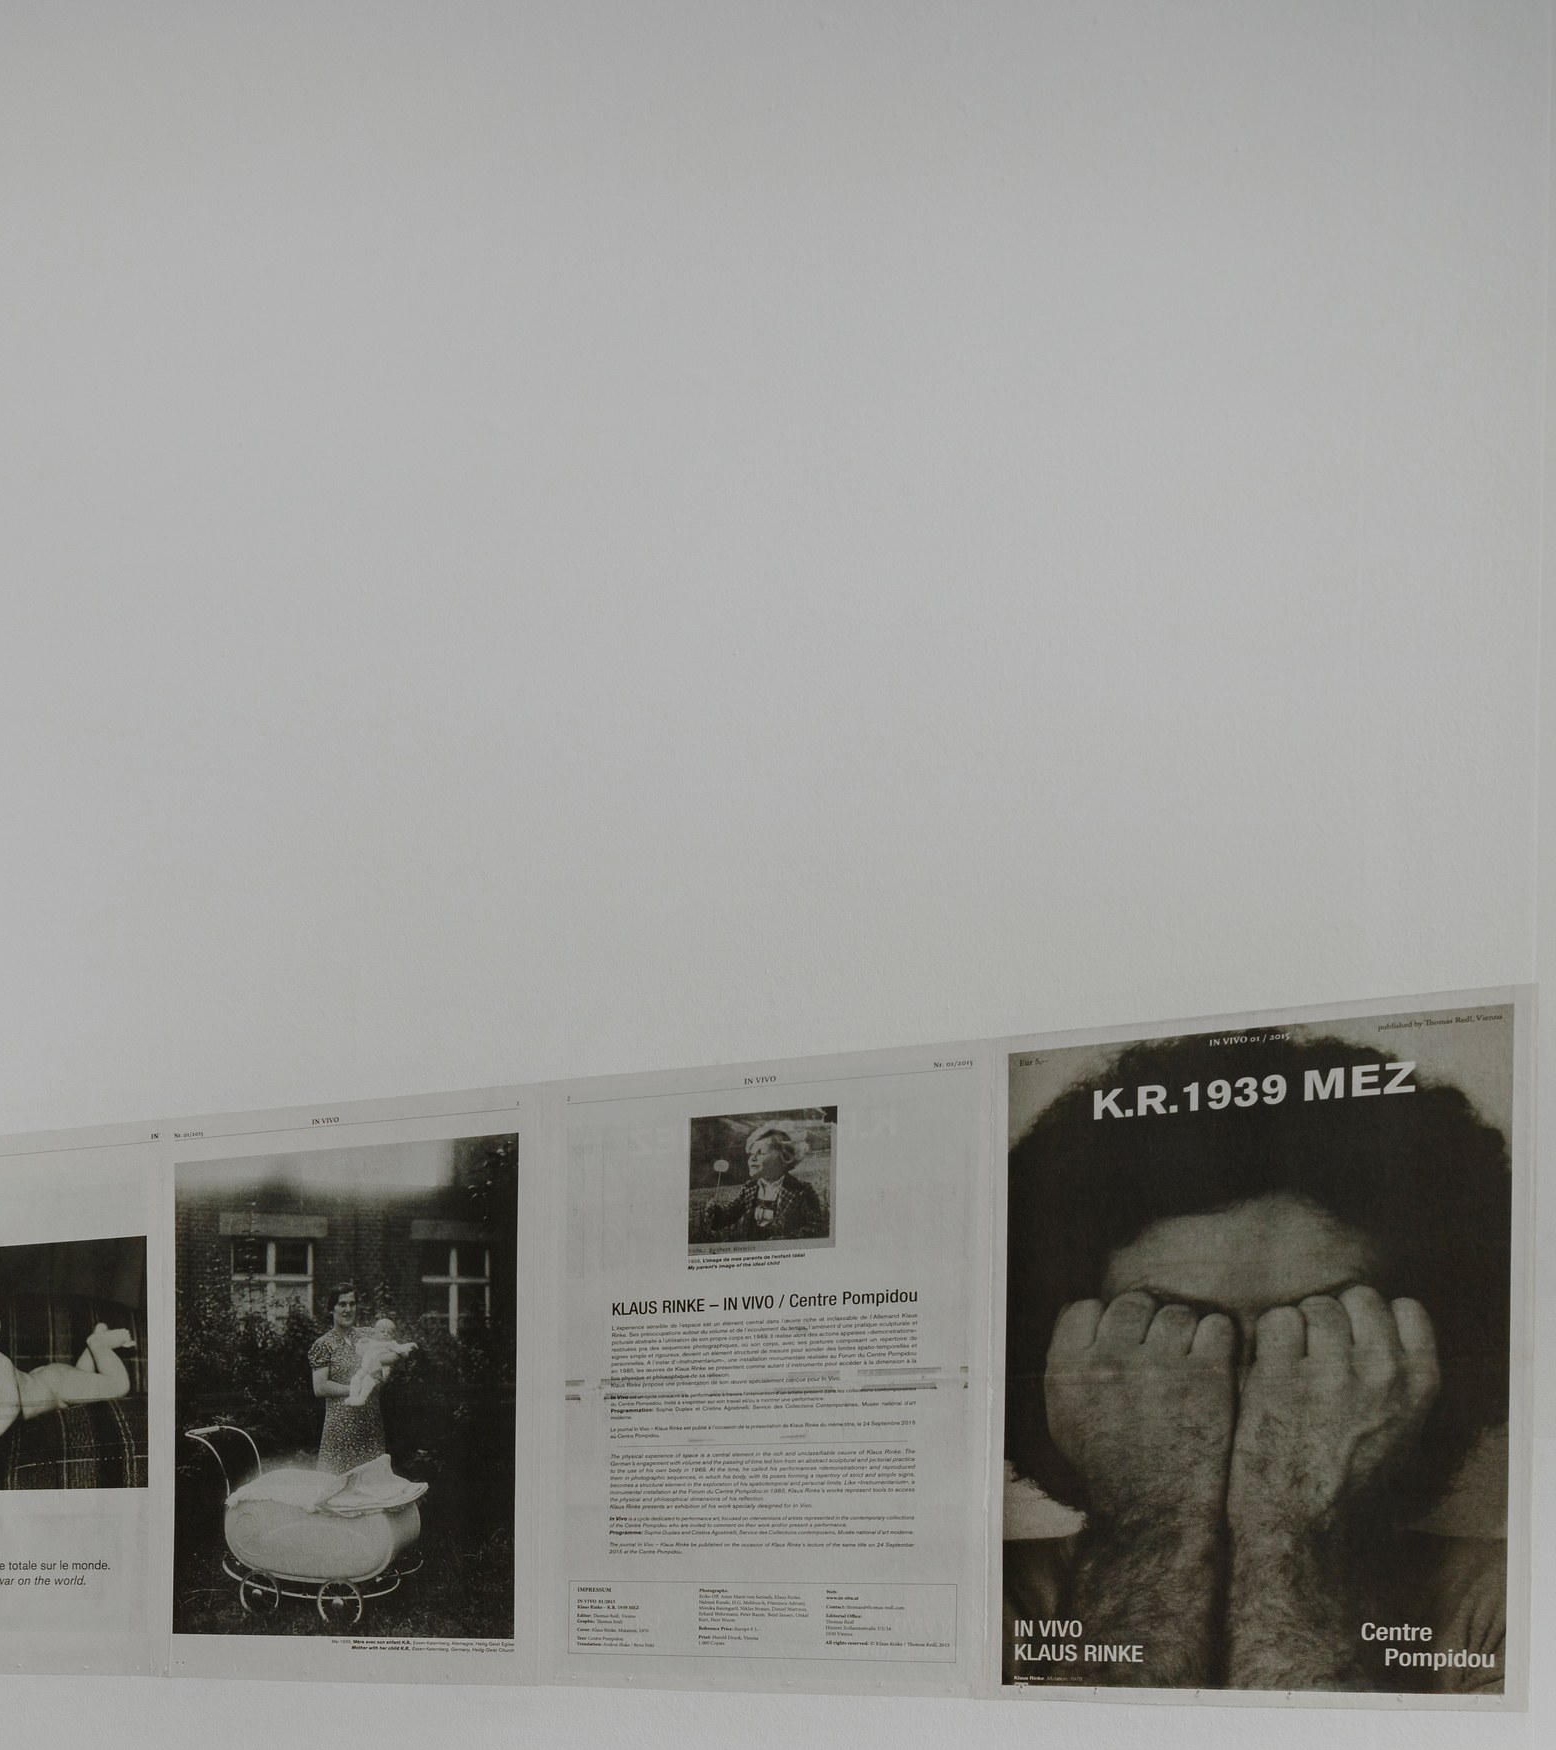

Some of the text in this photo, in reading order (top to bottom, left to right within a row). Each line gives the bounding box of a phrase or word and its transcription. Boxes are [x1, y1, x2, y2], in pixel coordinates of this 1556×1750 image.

[1378, 1021, 1412, 1032] published
[1414, 1020, 1423, 1029] by
[1223, 1036, 1248, 1045] VIVO
[1269, 1032, 1291, 1041] 2015
[1093, 1062, 1416, 1120] K.R.1939 MEZ
[612, 1300, 658, 1316] KLAUS
[662, 1298, 705, 1314] RINKE
[723, 1297, 738, 1311] IN
[741, 1295, 774, 1310] VIVO
[778, 1294, 785, 1308] /
[789, 1293, 837, 1308] Centre
[842, 1289, 917, 1307] Pompidou
[9, 1560, 37, 1570] totale
[60, 1560, 69, 1570] le
[72, 1560, 110, 1570] monde.
[34, 1576, 51, 1585] the
[54, 1576, 86, 1585] world.
[1014, 1620, 1083, 1638] IN VIVO
[1361, 1622, 1432, 1641] Centre
[1014, 1644, 1143, 1662] KLAUS RINKE
[1384, 1648, 1495, 1671] Pompidou
